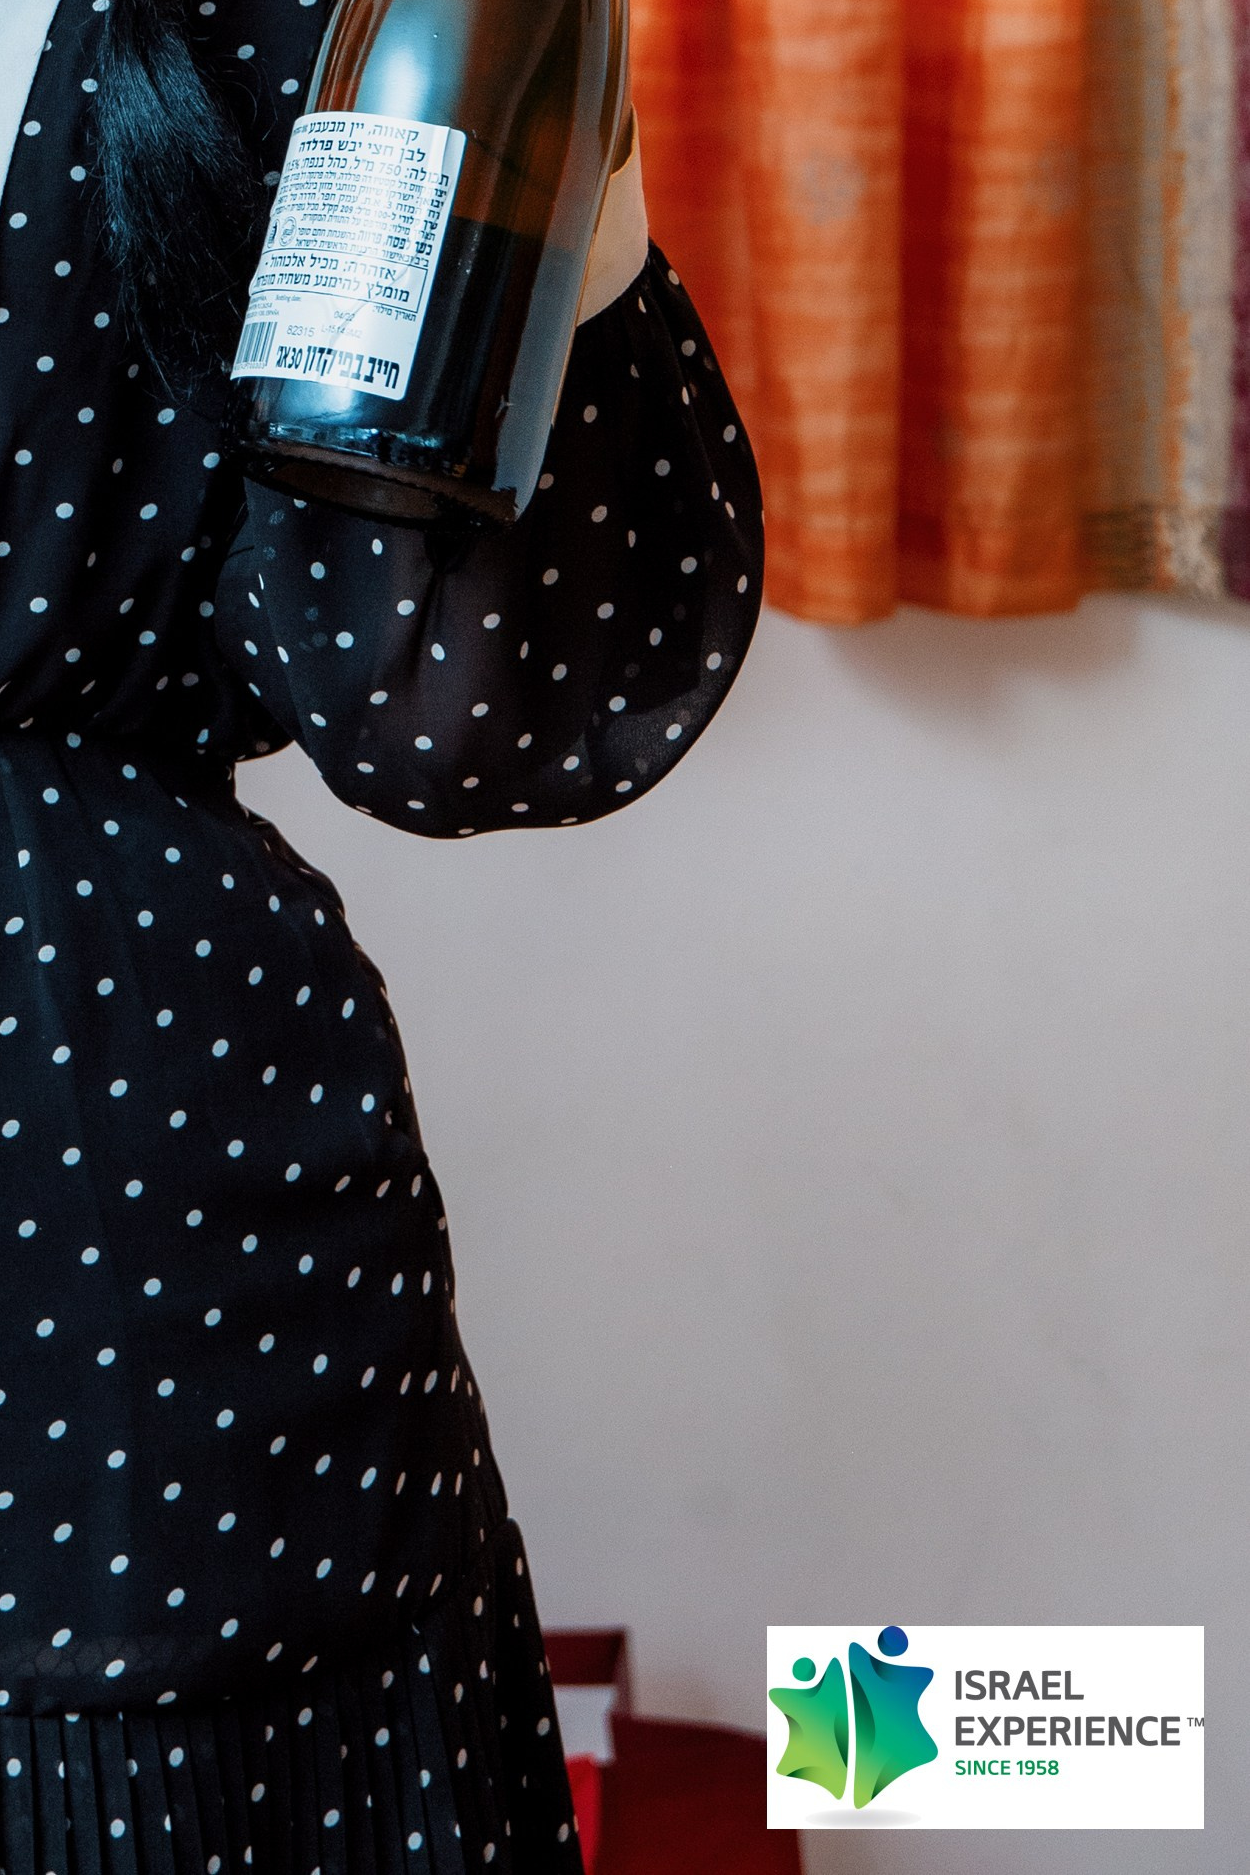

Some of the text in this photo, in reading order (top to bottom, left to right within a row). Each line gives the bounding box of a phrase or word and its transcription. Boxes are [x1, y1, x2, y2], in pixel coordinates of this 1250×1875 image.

[307, 122, 345, 134] מבעבע
[349, 122, 364, 138] יין
[367, 125, 419, 145] קאווה,
[299, 138, 426, 164] לבן חצי יבש פרלדה
[379, 162, 402, 176] 750
[404, 166, 449, 186] תכולה:
[415, 240, 433, 256] כשר
[310, 253, 339, 270] מכיל
[276, 273, 311, 286] משתיה
[343, 260, 397, 282] אזהרה:
[313, 275, 360, 291] להימנע
[366, 281, 410, 303] מומלץ
[286, 324, 315, 337] 82315
[302, 345, 365, 382] בפיקדון
[363, 356, 400, 389] חייב
